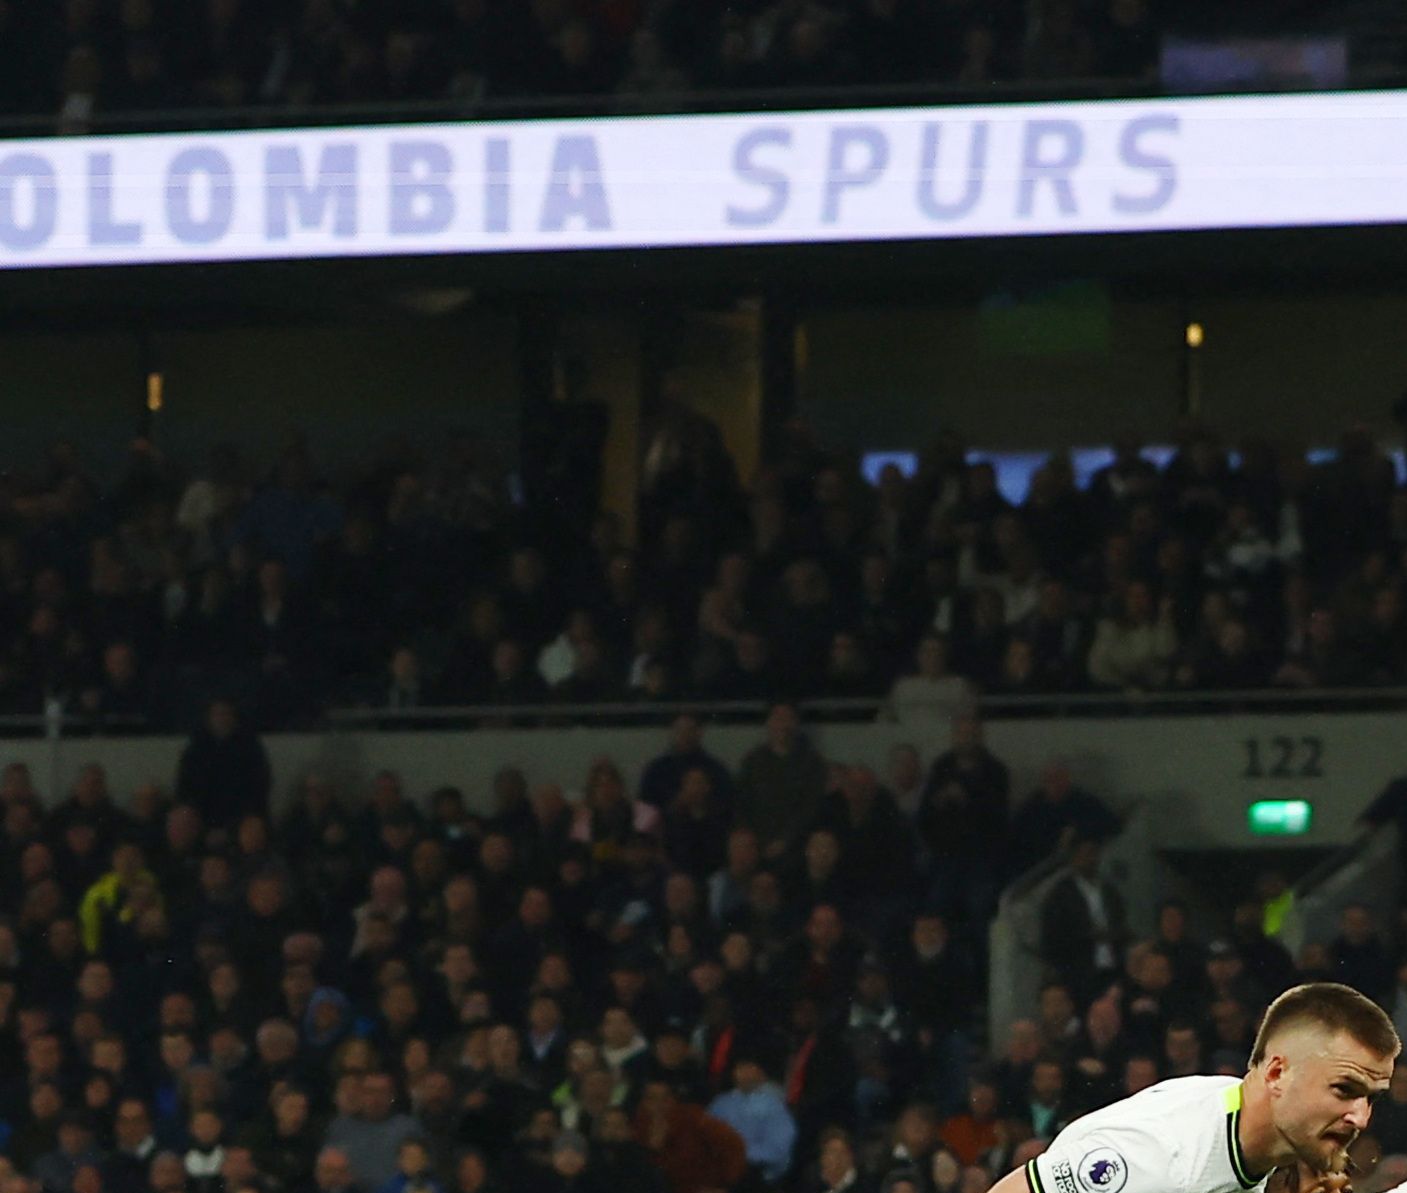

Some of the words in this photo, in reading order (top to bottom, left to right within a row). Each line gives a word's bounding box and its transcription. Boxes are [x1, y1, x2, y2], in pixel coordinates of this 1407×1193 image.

[0, 133, 615, 252] OLOMBIA
[725, 115, 1184, 230] SPURS
[1245, 736, 1323, 778] 122
